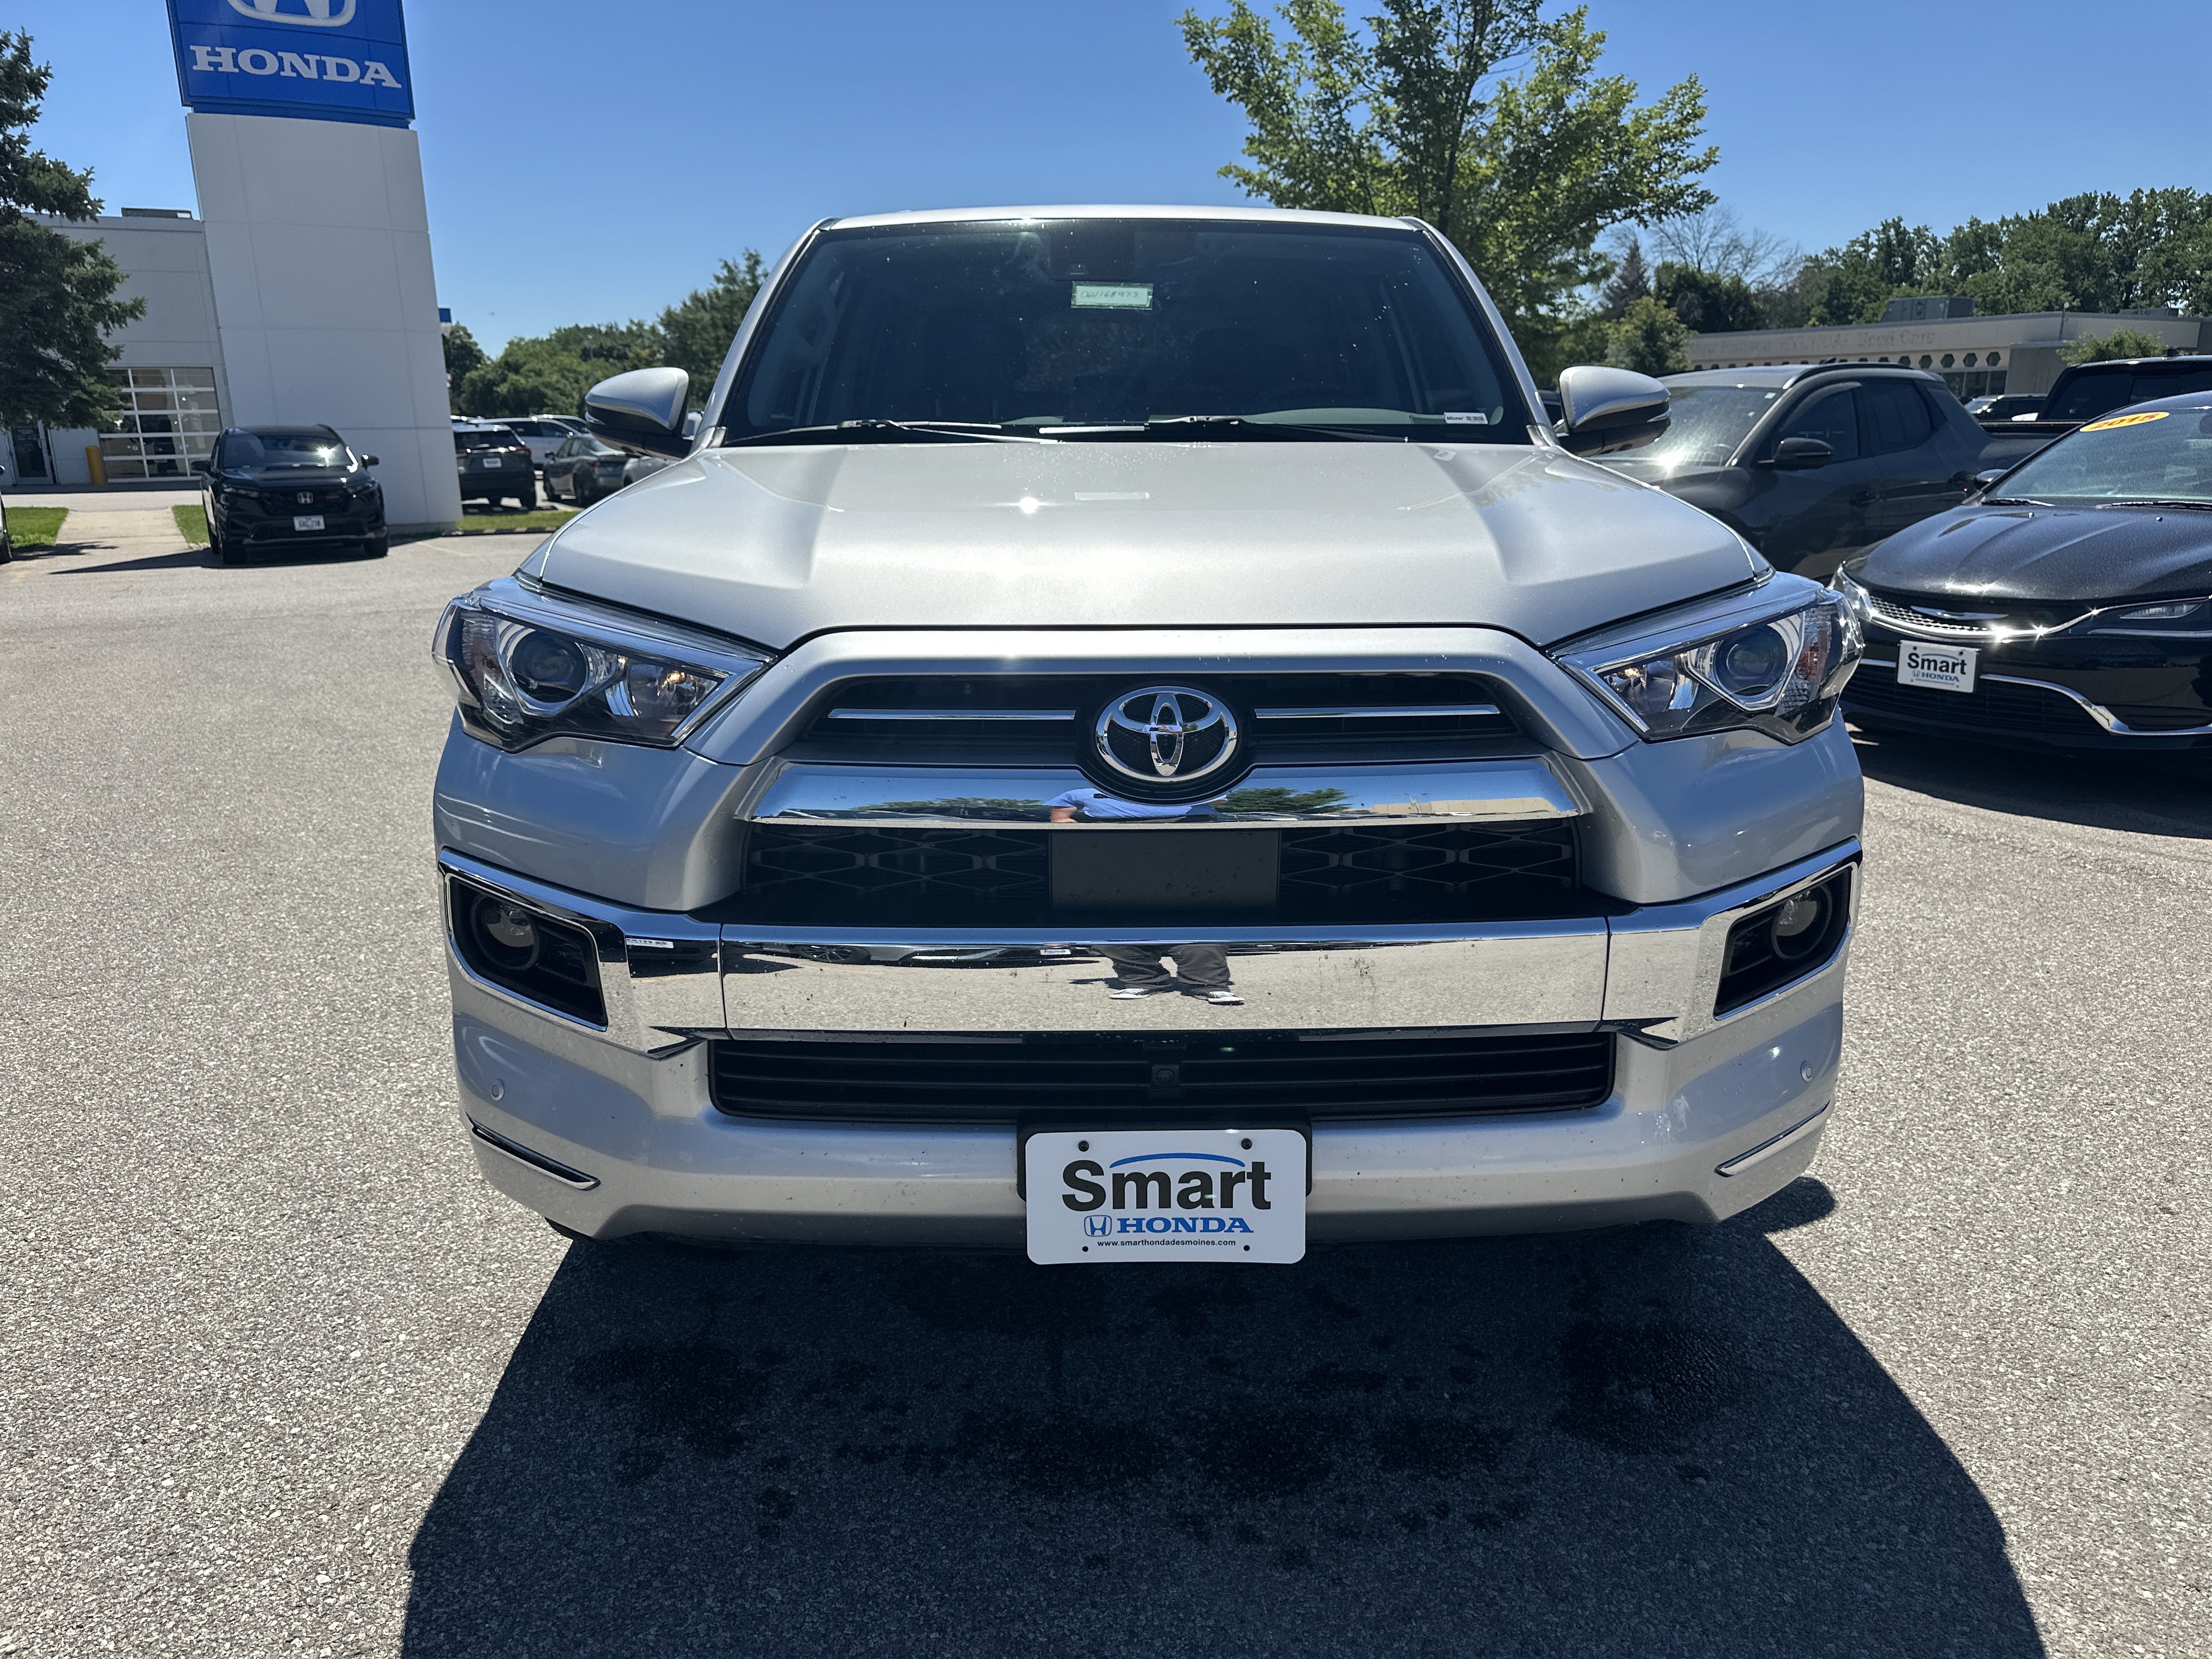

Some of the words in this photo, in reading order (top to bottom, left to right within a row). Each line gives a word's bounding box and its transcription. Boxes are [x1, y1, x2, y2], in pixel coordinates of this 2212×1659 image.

[189, 45, 402, 89] HONDA
[2089, 413, 2160, 430] 2015
[1907, 652, 1967, 675] Smart
[1921, 673, 1960, 682] HONDA
[1062, 1160, 1272, 1211] Smart
[1117, 1217, 1254, 1234] HONDA
